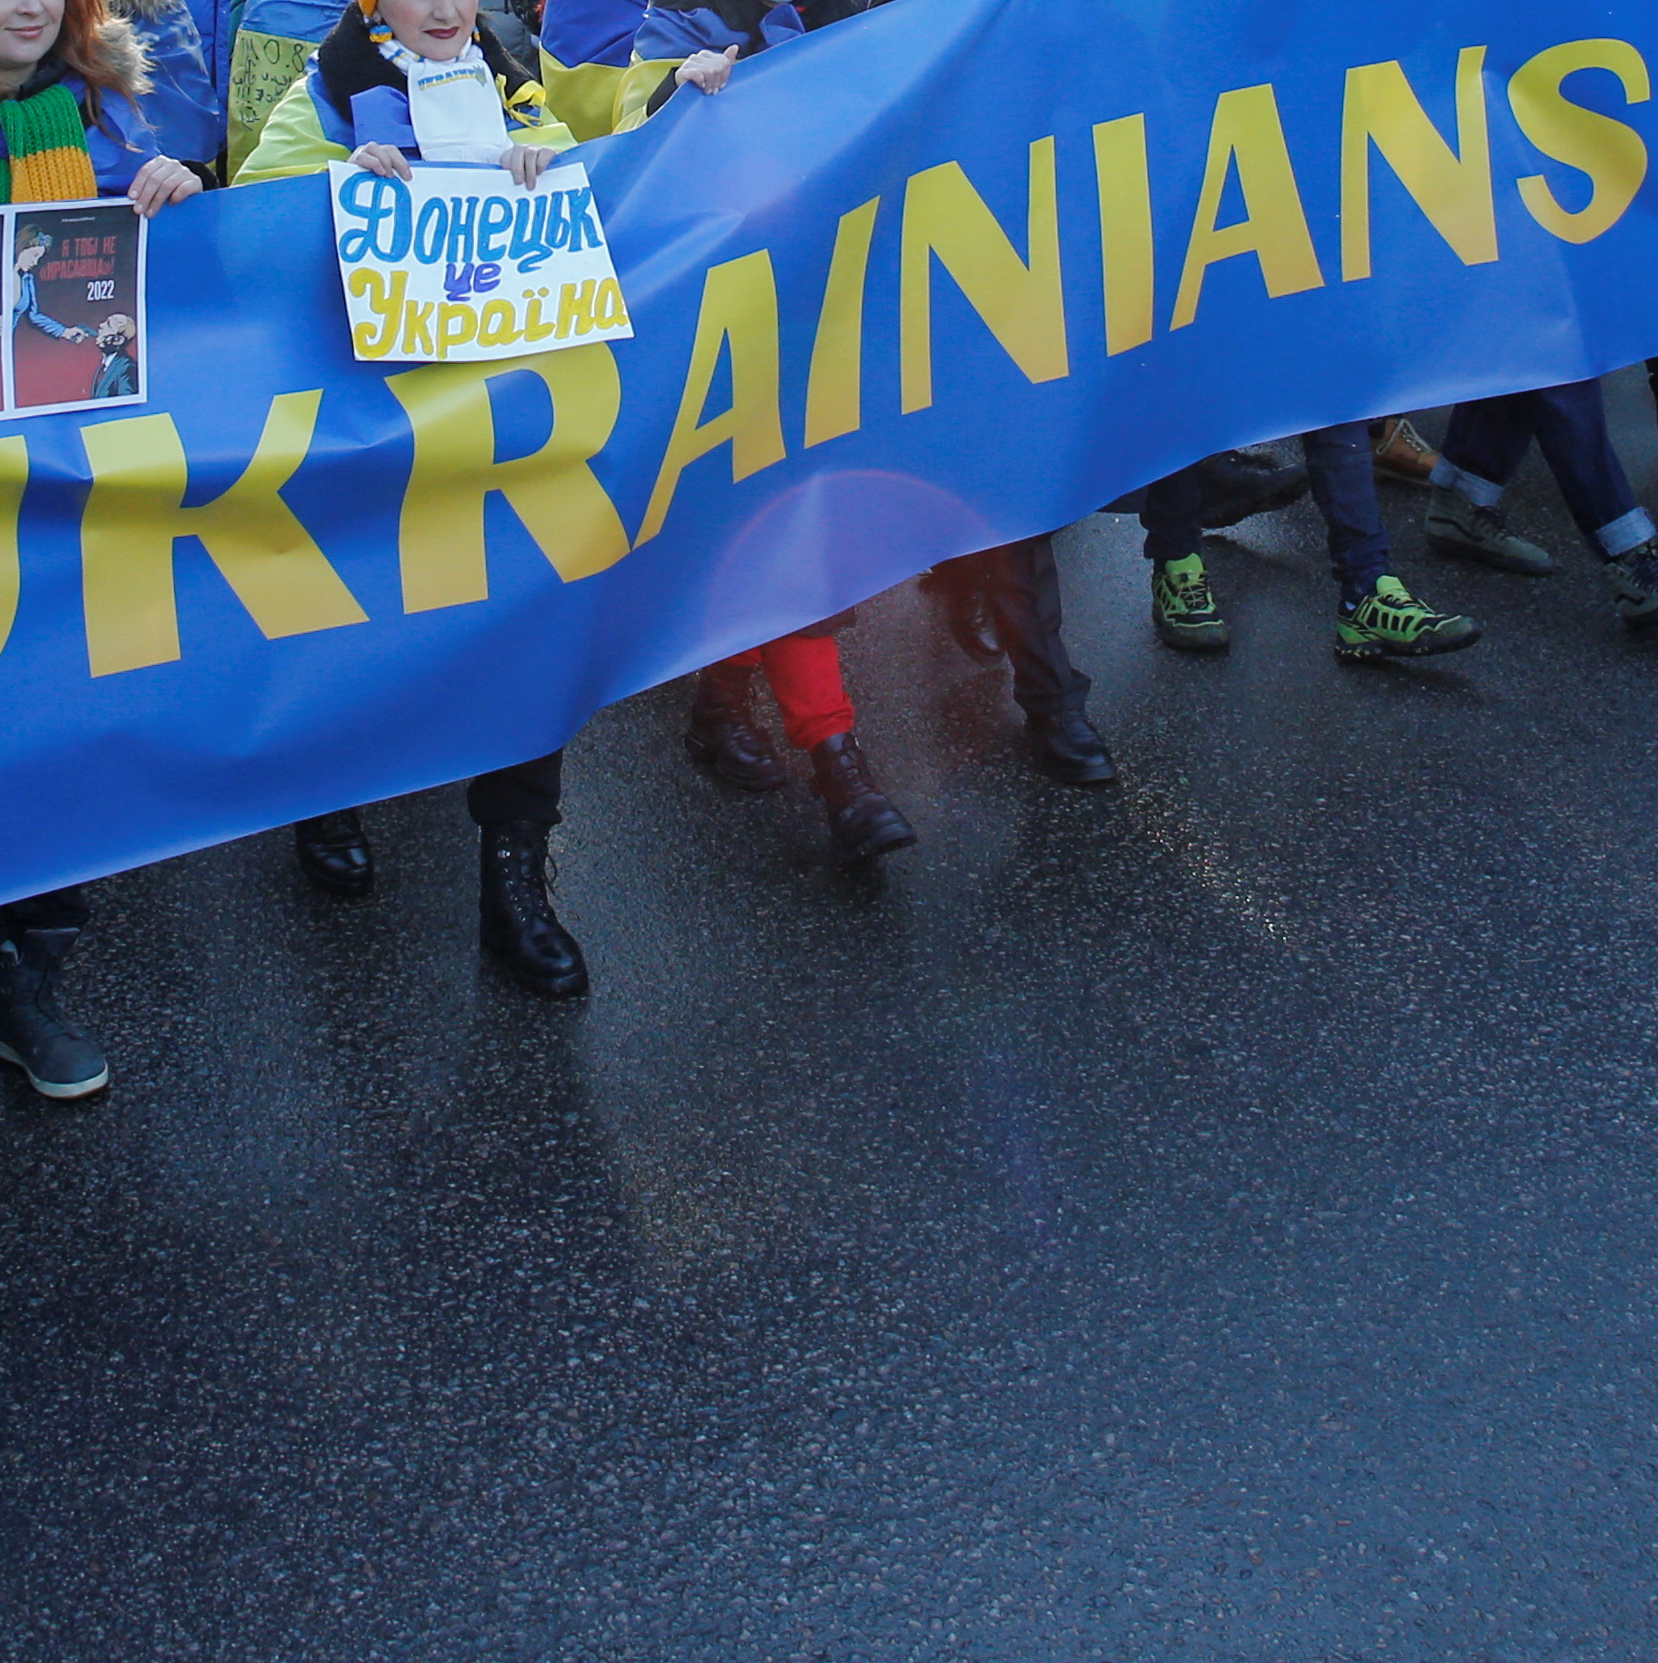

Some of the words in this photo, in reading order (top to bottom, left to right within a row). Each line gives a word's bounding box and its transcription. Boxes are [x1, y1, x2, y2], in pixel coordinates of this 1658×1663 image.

[338, 171, 605, 274] Донецьк
[61, 239, 71, 257] Я
[74, 237, 99, 256] ТОБІ
[102, 236, 118, 255] НЕ
[86, 279, 115, 301] 2022
[443, 262, 502, 302] це
[348, 267, 630, 360] Україна
